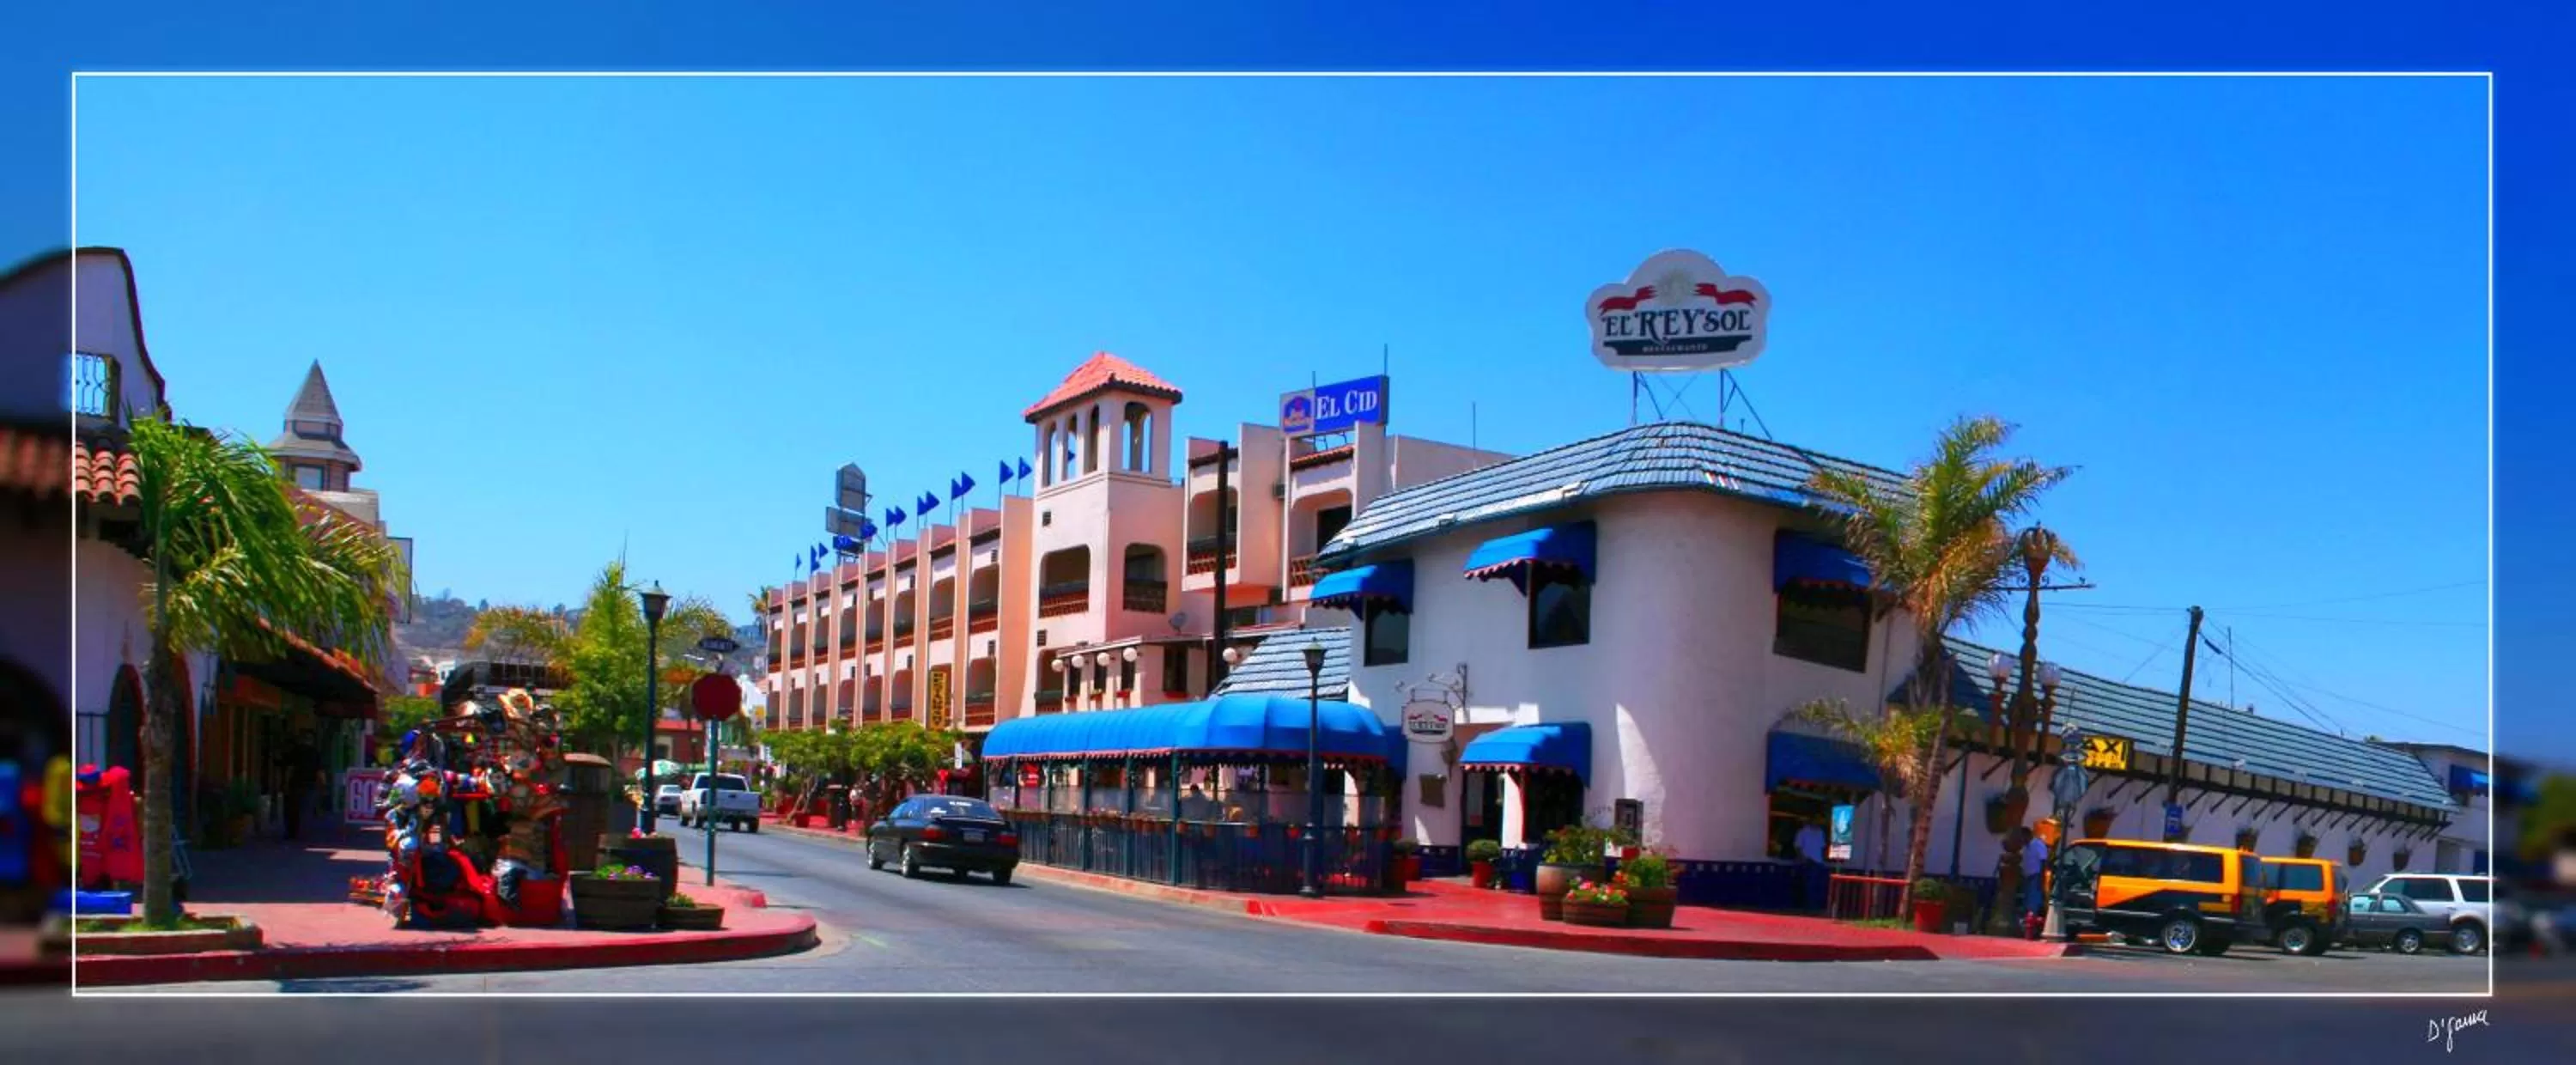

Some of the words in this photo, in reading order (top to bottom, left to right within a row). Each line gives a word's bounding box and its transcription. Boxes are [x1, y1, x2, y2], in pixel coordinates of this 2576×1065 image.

[1601, 314, 1631, 337] EL
[1634, 308, 1704, 344] REY
[1703, 309, 1752, 332] SOL
[1315, 395, 1340, 420] EL
[1344, 389, 1377, 415] CID
[2081, 736, 2127, 762] AXI
